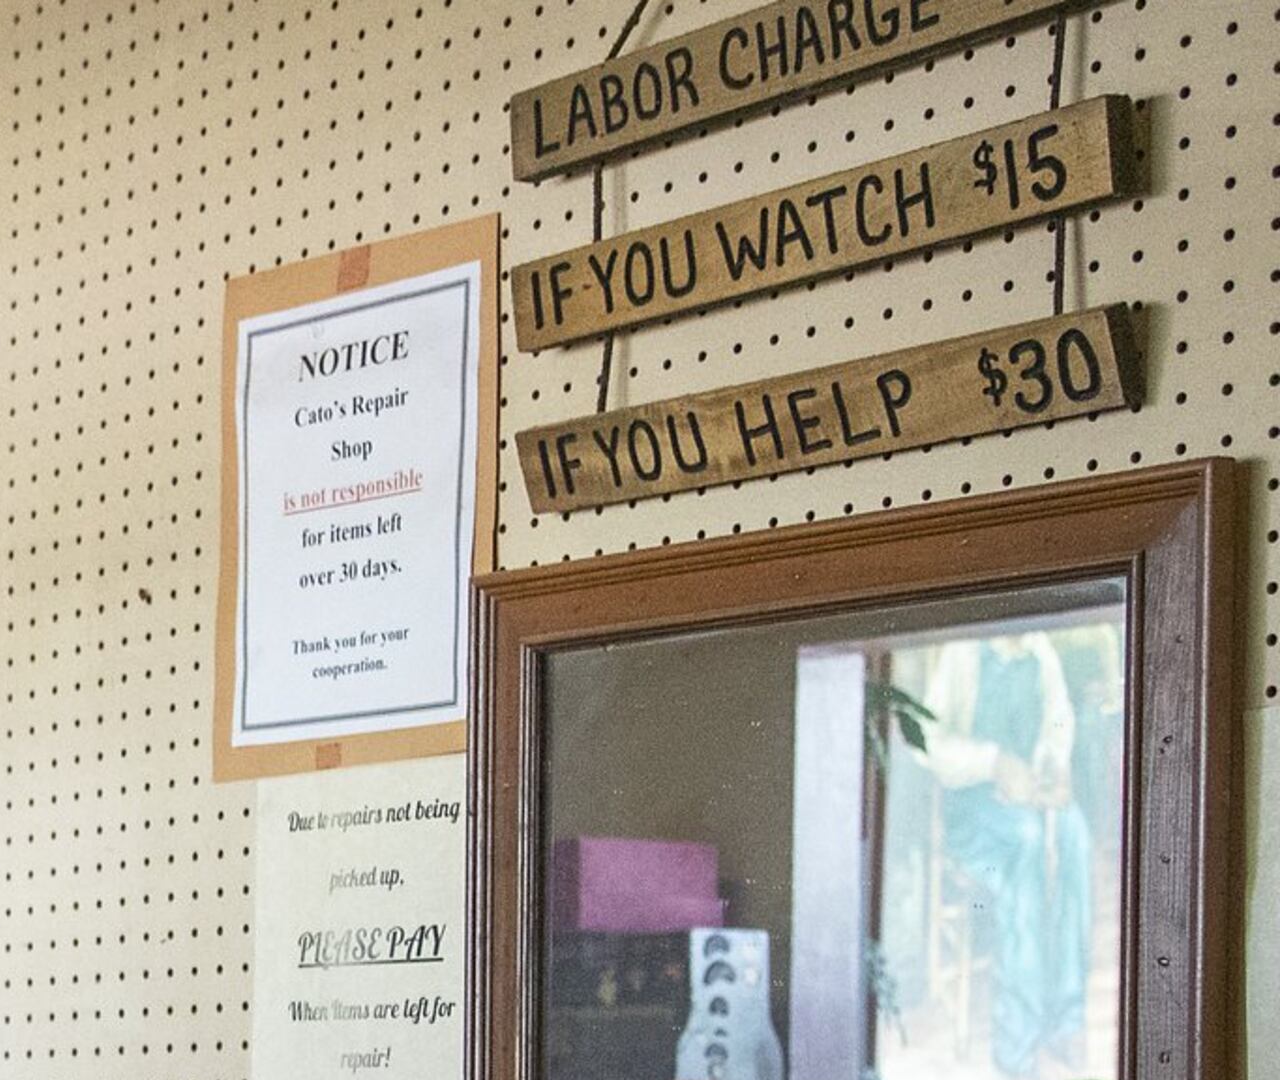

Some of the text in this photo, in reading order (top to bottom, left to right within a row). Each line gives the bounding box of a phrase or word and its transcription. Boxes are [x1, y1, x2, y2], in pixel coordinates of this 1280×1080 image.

[534, 46, 702, 158] LABOR
[530, 125, 1069, 330] IF YOU WATCH $15
[298, 330, 410, 382] NOTICE
[295, 388, 409, 428] Cato's Repair
[536, 328, 1103, 499] IF YOU HELP $30
[331, 439, 373, 462] Shop
[282, 469, 423, 511] is not responsible
[301, 514, 402, 548] for items left
[299, 556, 402, 588] over 30 days.
[292, 627, 409, 655] Thank you for your
[312, 659, 387, 679] cooperation.
[288, 799, 460, 832] Due to repairs not being
[329, 868, 404, 894] picked up.
[298, 924, 447, 965] PLEASE PAY
[288, 1001, 328, 1021] When
[373, 1004, 400, 1019] are
[403, 997, 430, 1023] left
[430, 997, 456, 1025] for
[340, 1047, 391, 1072] repair!
